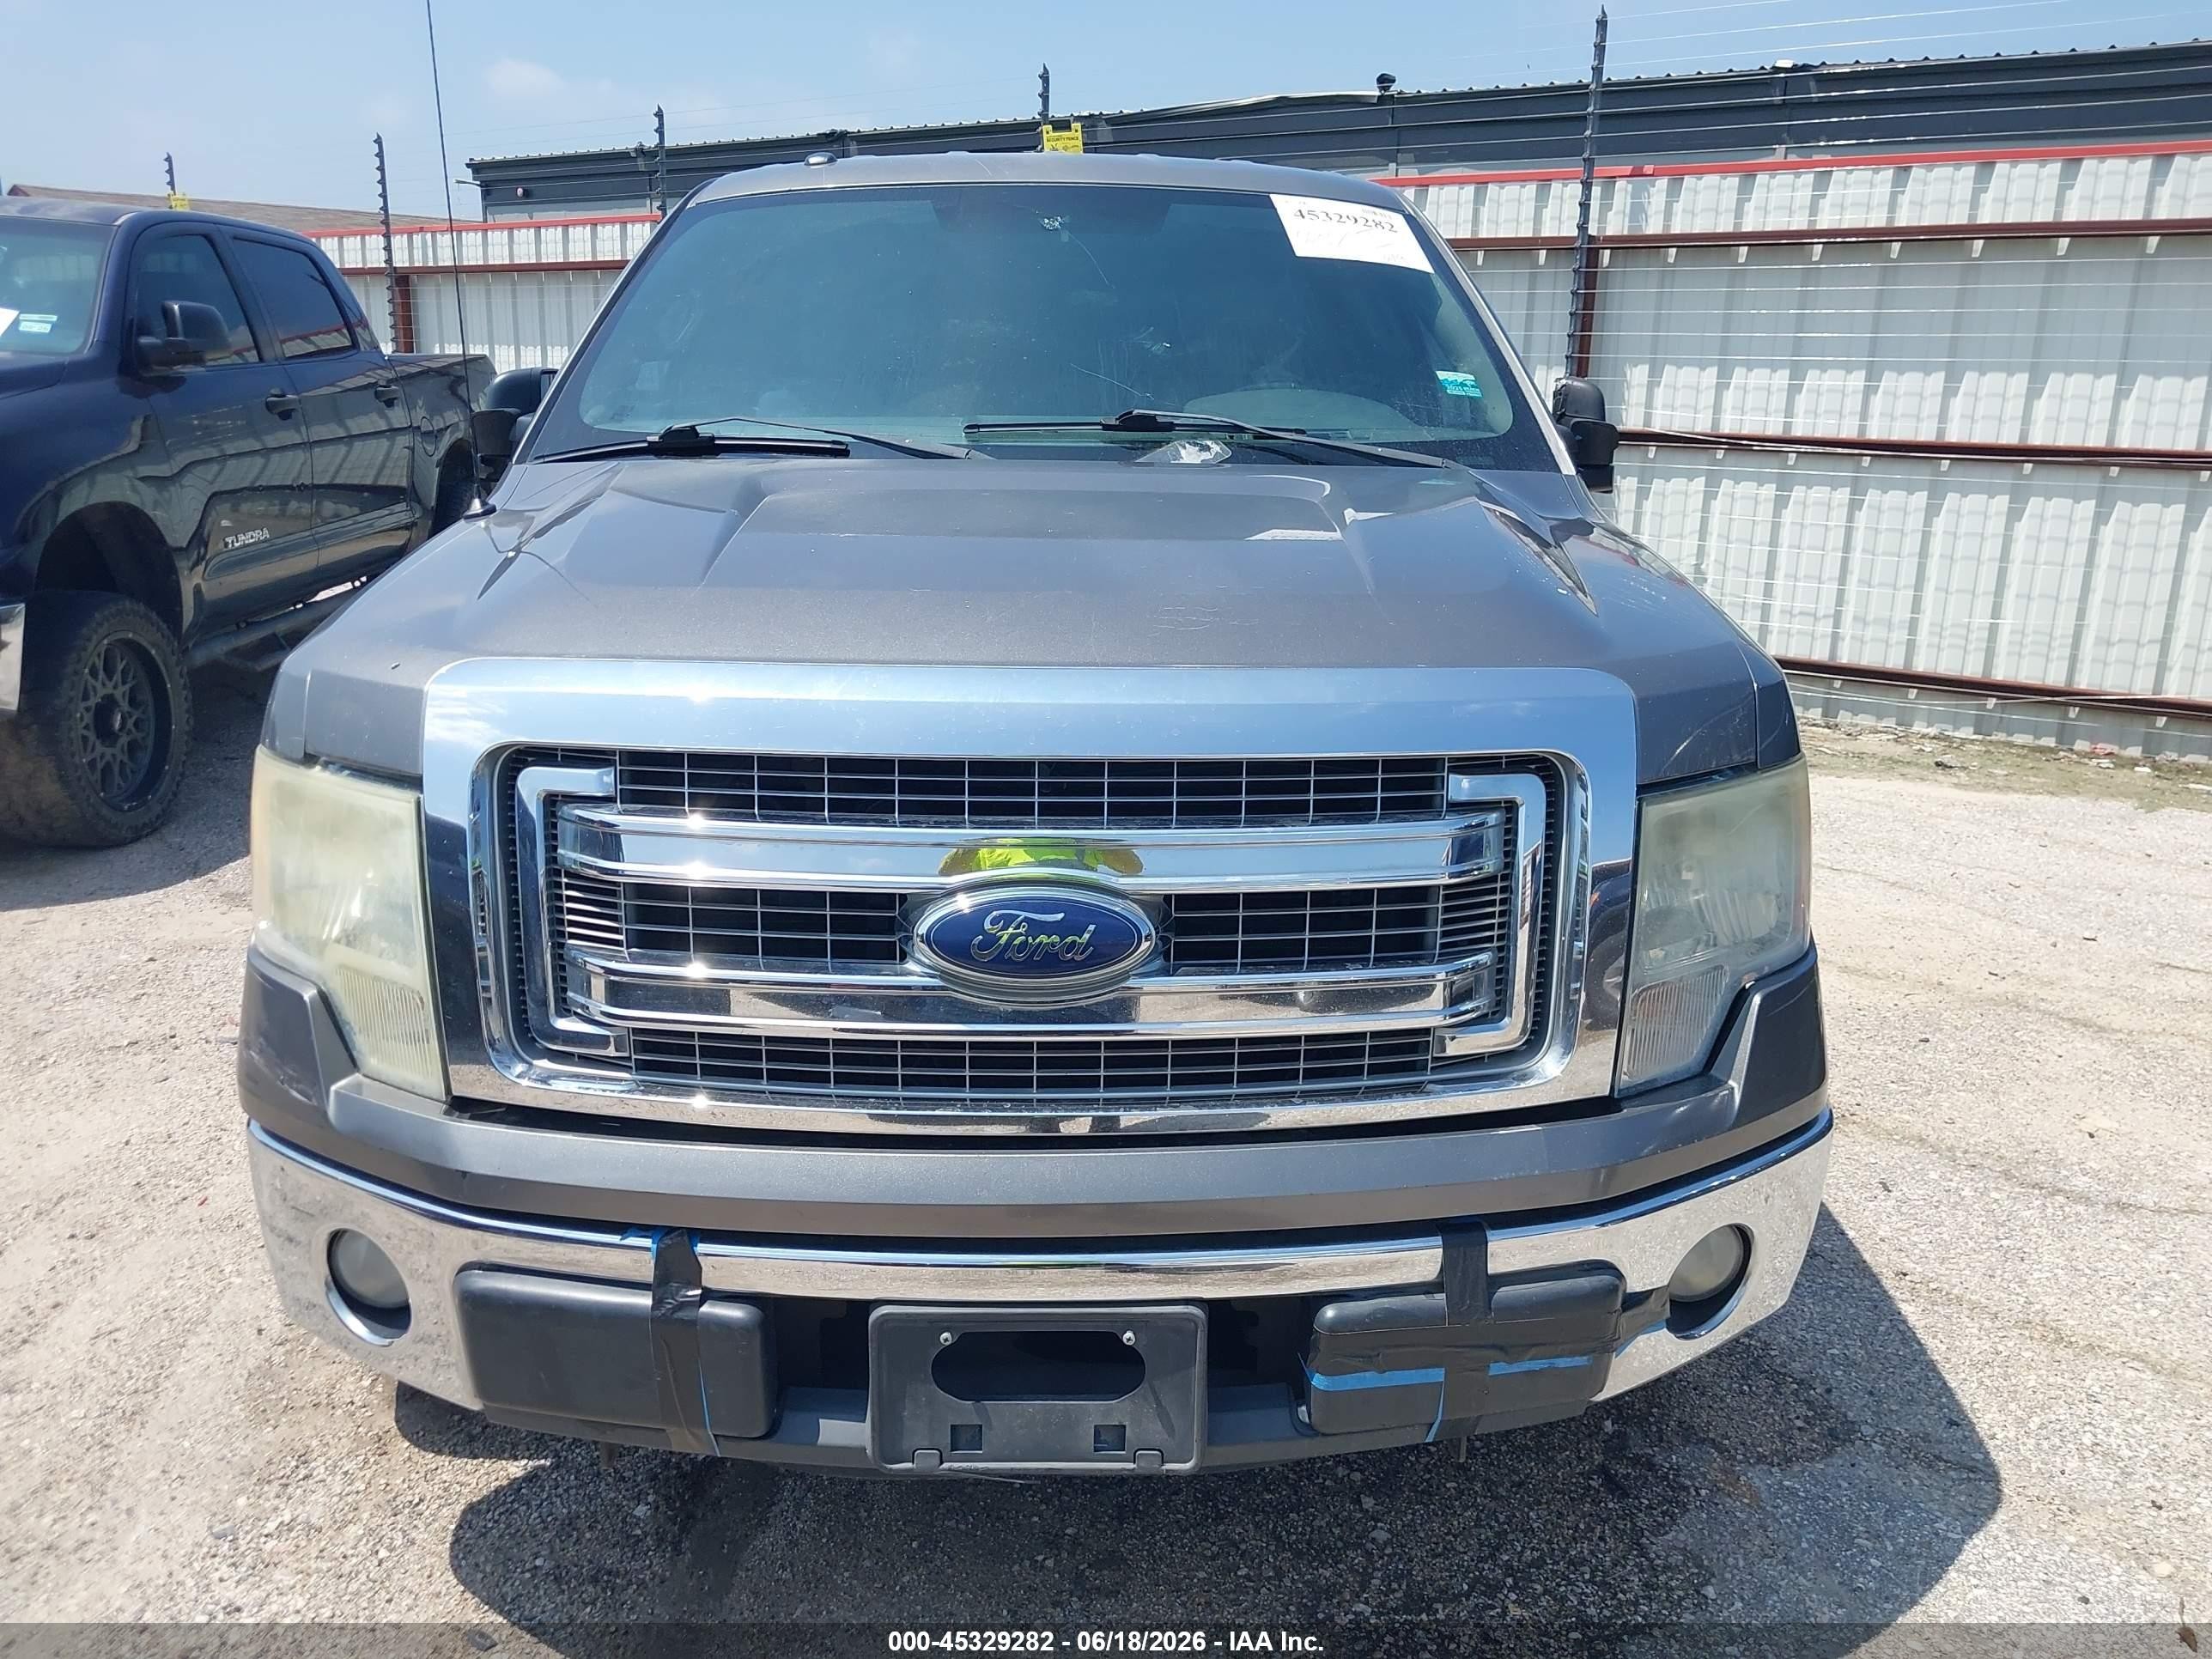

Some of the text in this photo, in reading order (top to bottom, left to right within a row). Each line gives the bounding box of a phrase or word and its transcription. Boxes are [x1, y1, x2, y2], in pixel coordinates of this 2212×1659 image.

[1293, 209, 1398, 234] 45329282
[224, 527, 270, 550] TUNDRA
[970, 909, 1097, 962] Ford
